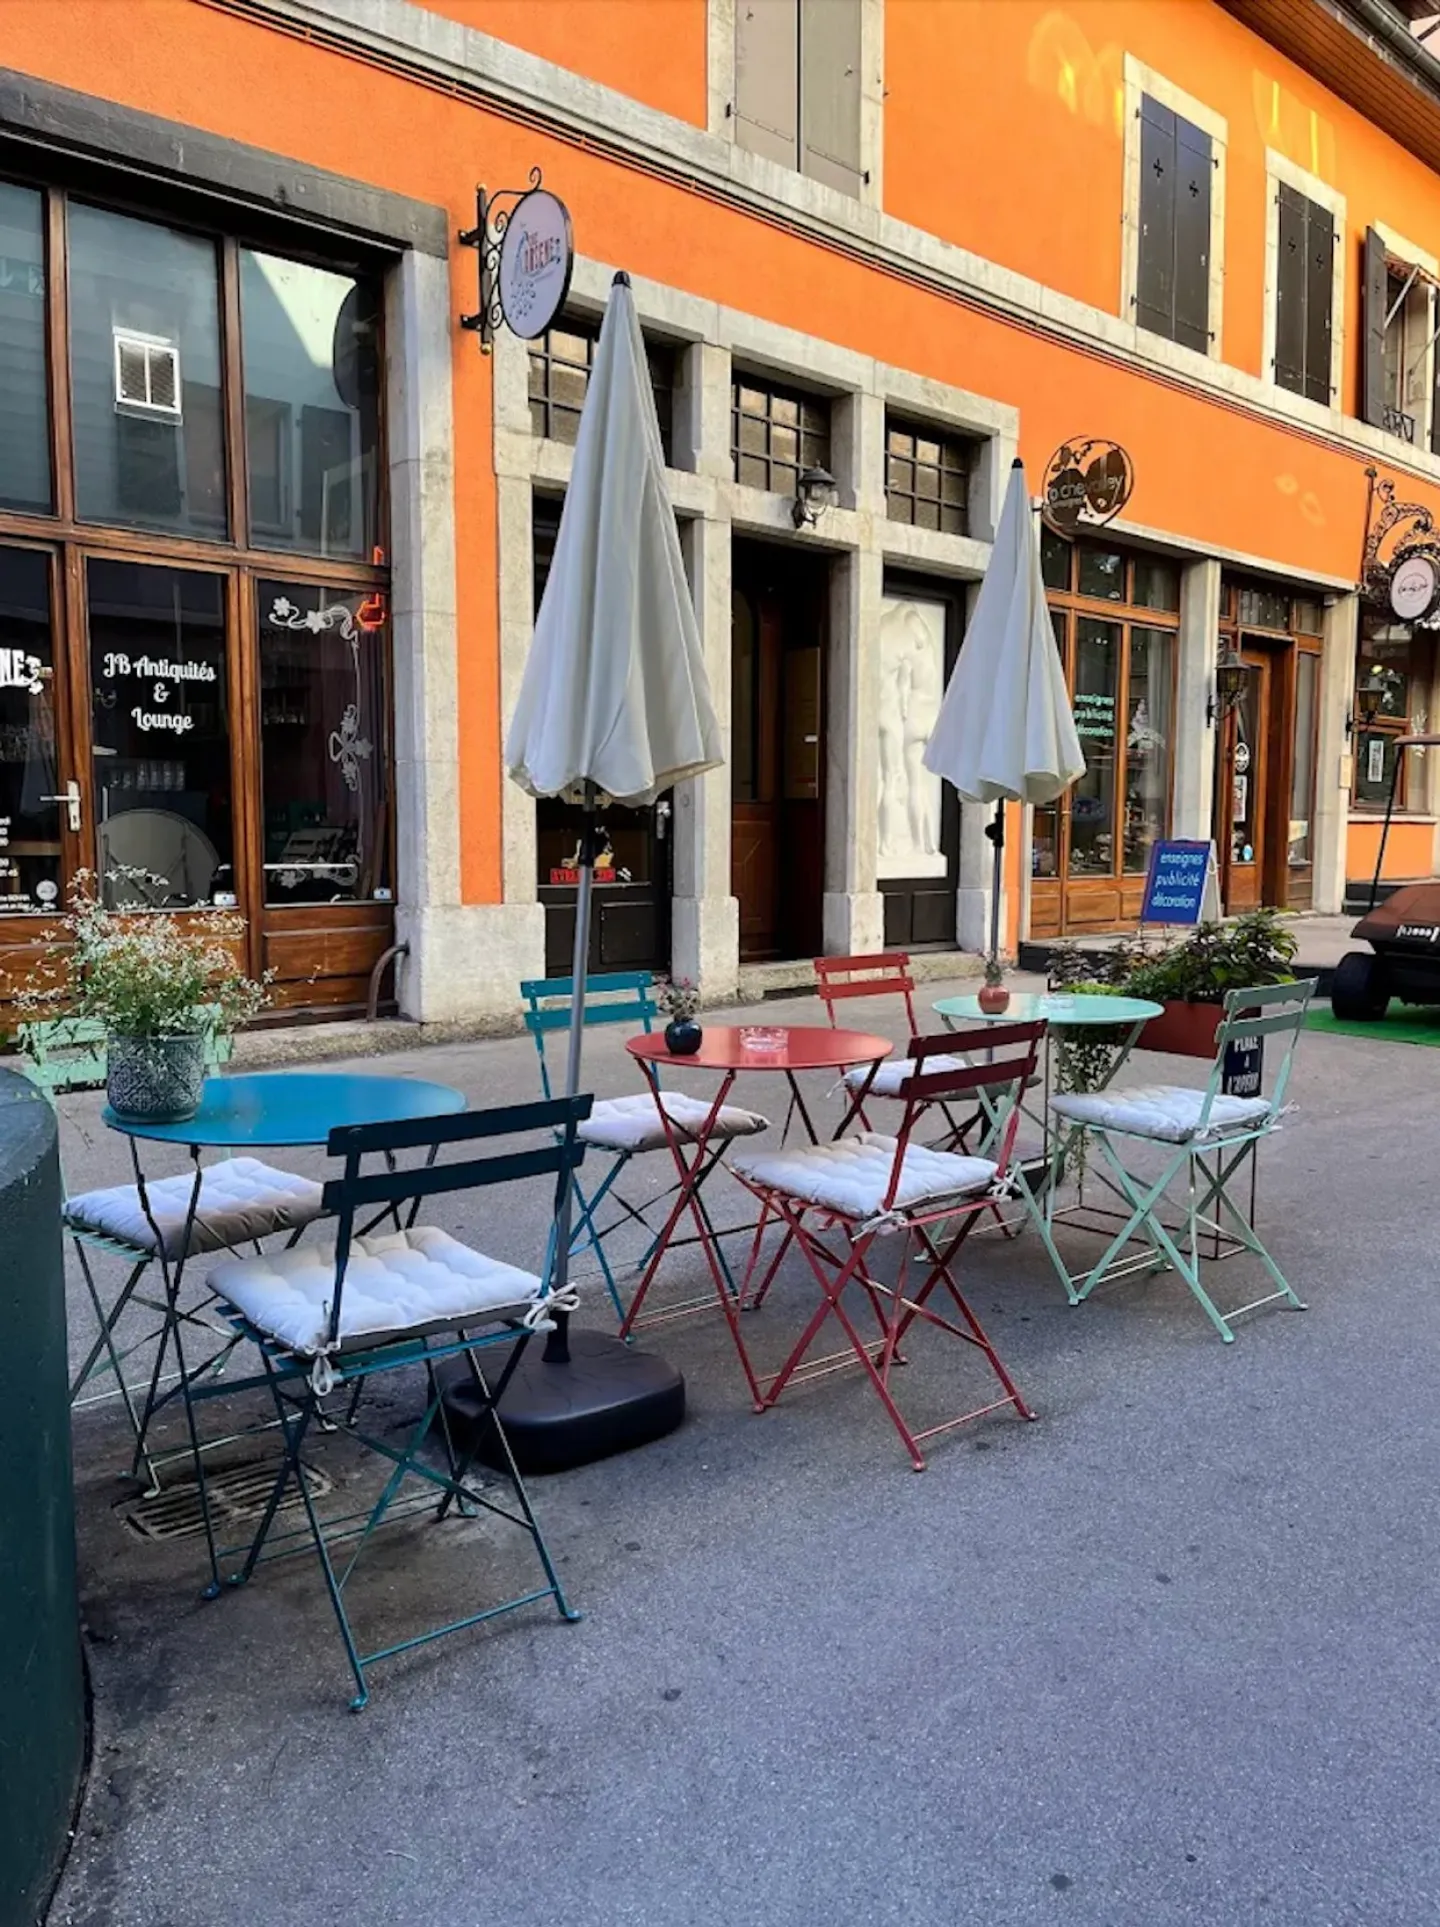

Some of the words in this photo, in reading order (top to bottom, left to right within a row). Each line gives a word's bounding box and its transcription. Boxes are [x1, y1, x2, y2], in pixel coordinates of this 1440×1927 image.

[102, 652, 131, 678] JB
[132, 655, 217, 684] Antiquités
[153, 681, 171, 703] &
[130, 706, 195, 735] Lounge
[1160, 850, 1204, 868] enseignes
[1155, 869, 1201, 889] publicité
[1151, 891, 1196, 909] décoration
